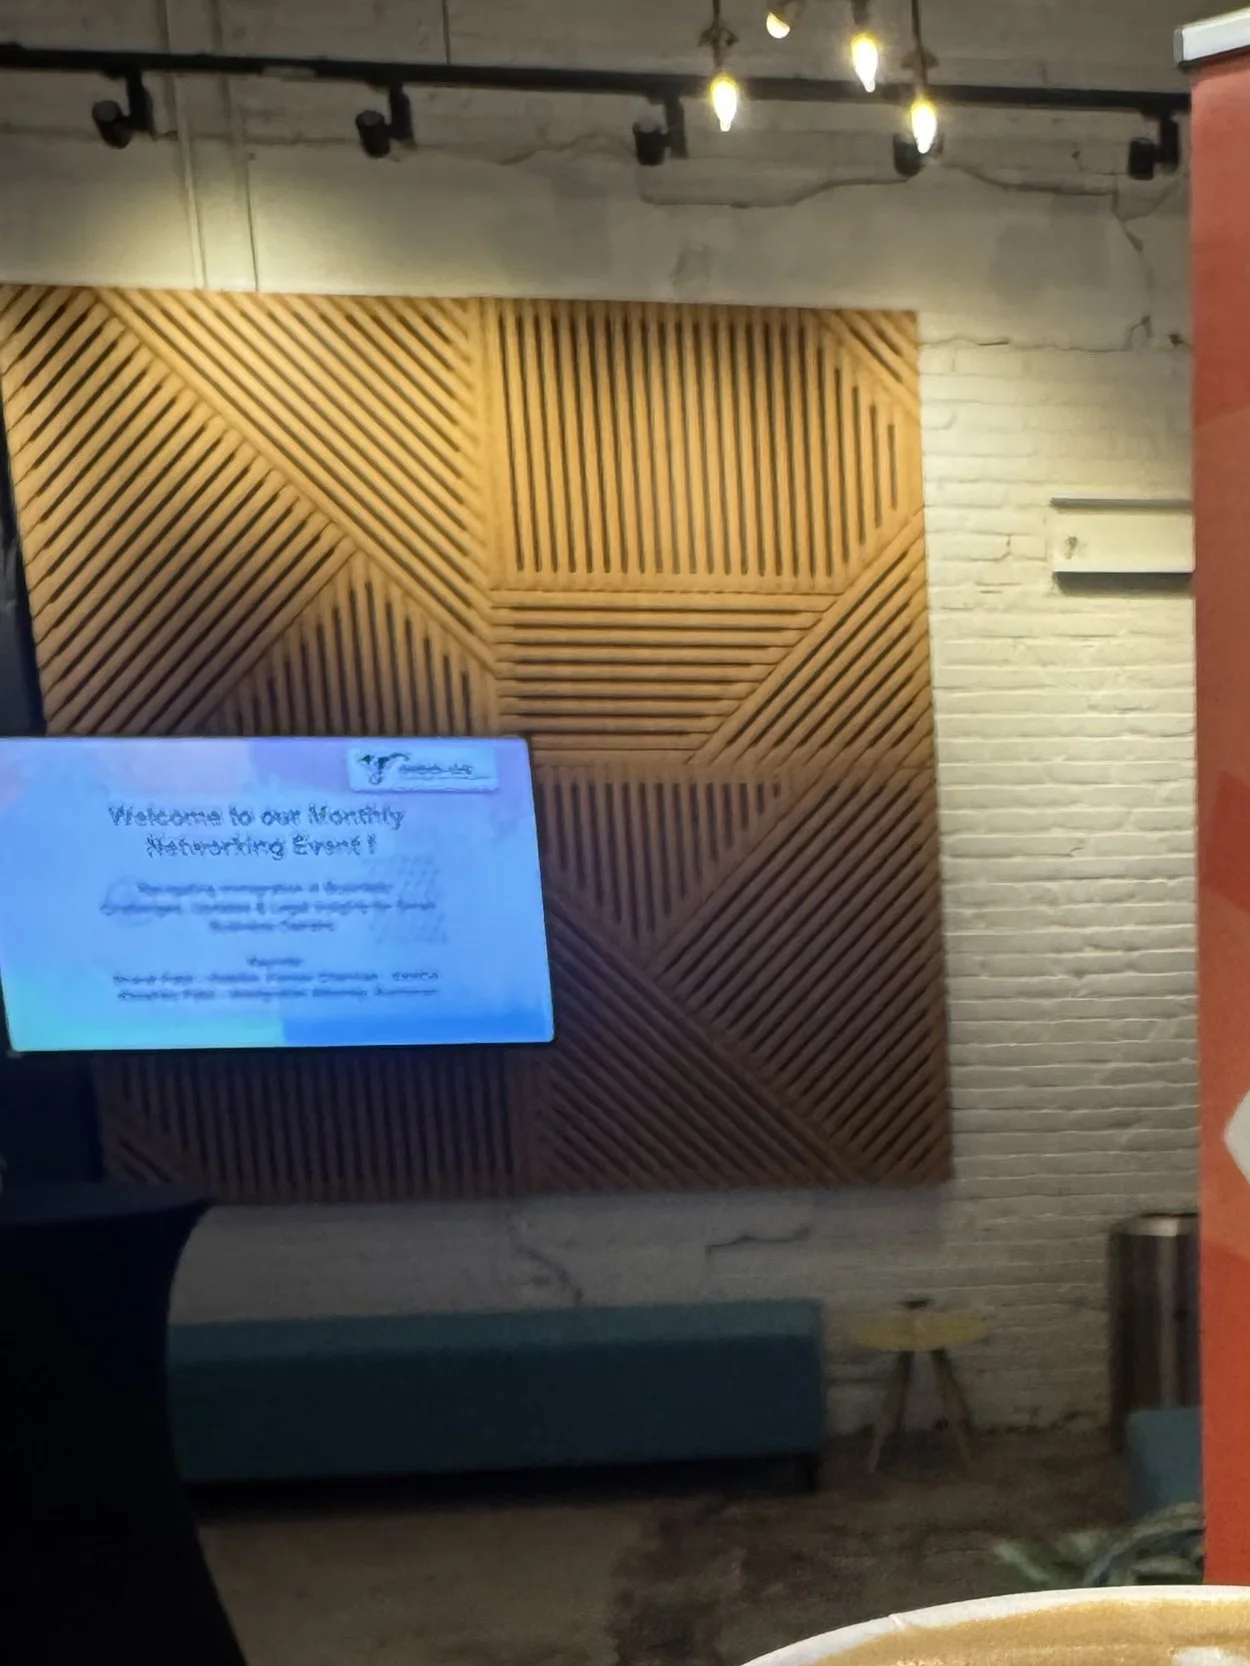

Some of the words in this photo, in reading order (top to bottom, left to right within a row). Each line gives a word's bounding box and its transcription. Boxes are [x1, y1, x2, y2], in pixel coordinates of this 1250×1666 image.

[107, 804, 223, 827] Welcome
[228, 804, 253, 827] to
[260, 808, 301, 827] our
[308, 803, 405, 831] Monthly
